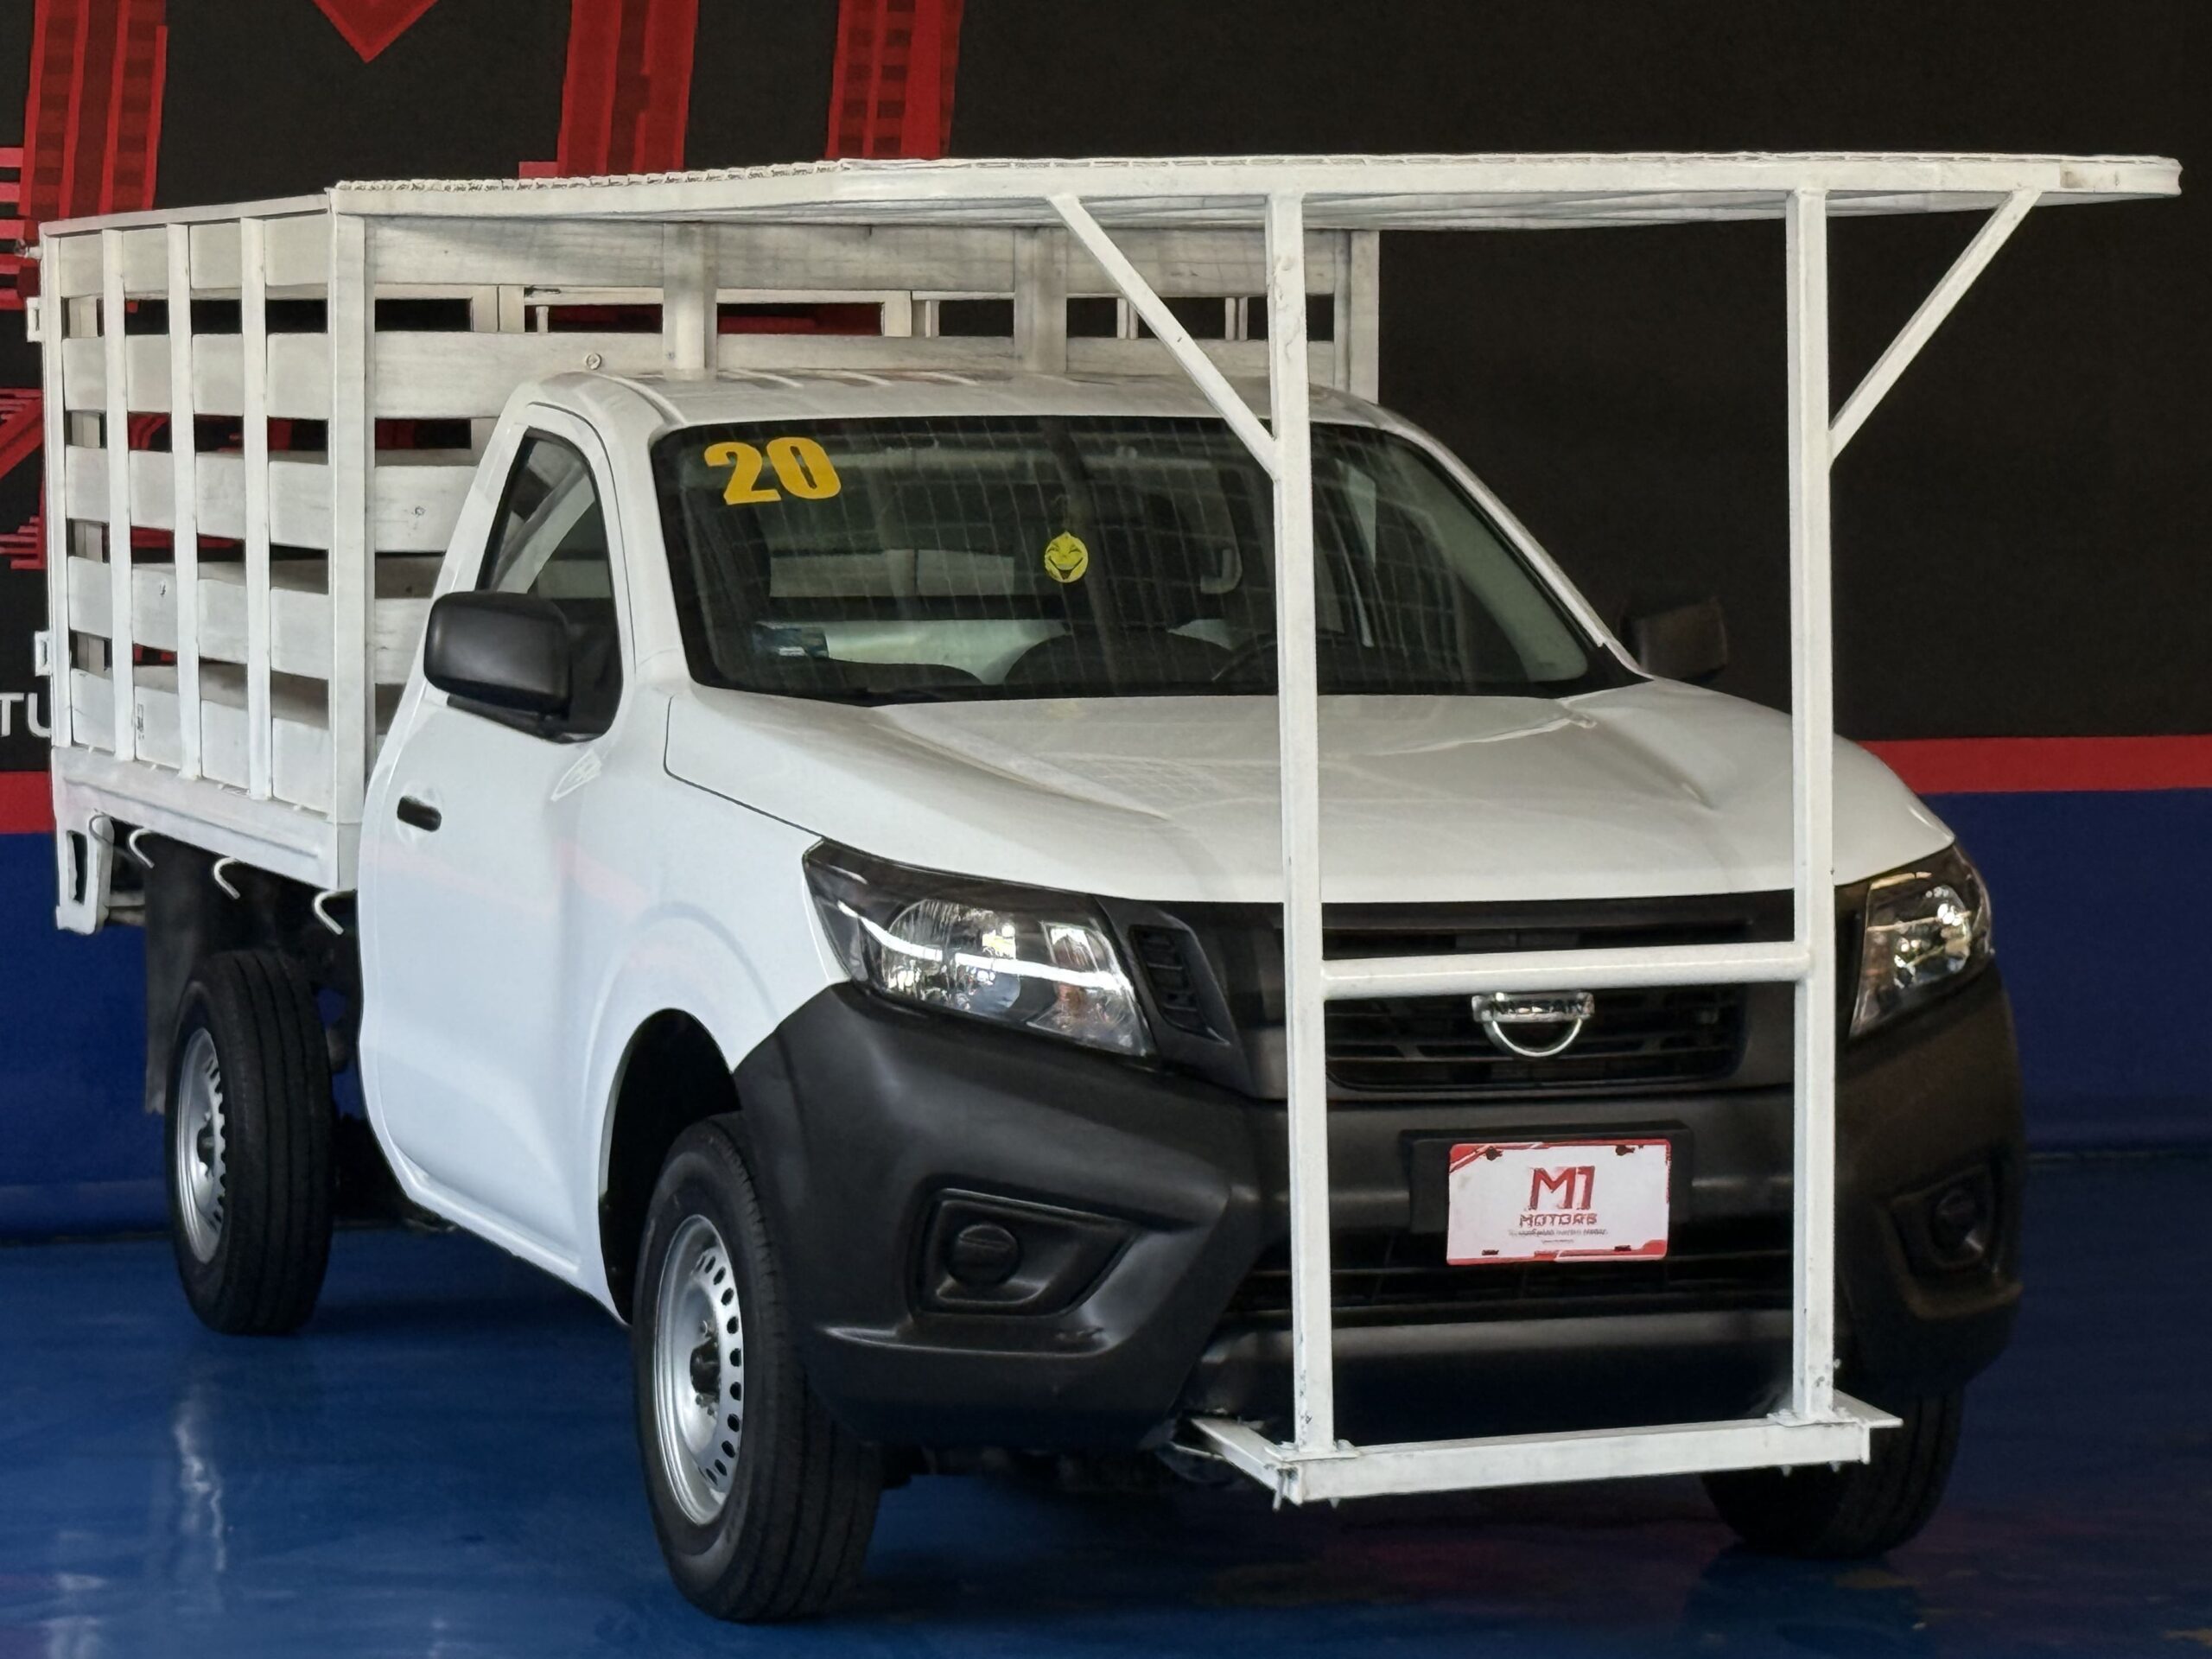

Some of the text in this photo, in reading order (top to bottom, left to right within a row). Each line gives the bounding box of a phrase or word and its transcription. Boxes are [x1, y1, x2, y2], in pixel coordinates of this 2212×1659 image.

[703, 436, 842, 505] 20
[1529, 1166, 1595, 1211] M1
[1519, 1213, 1598, 1227] MOTORS
